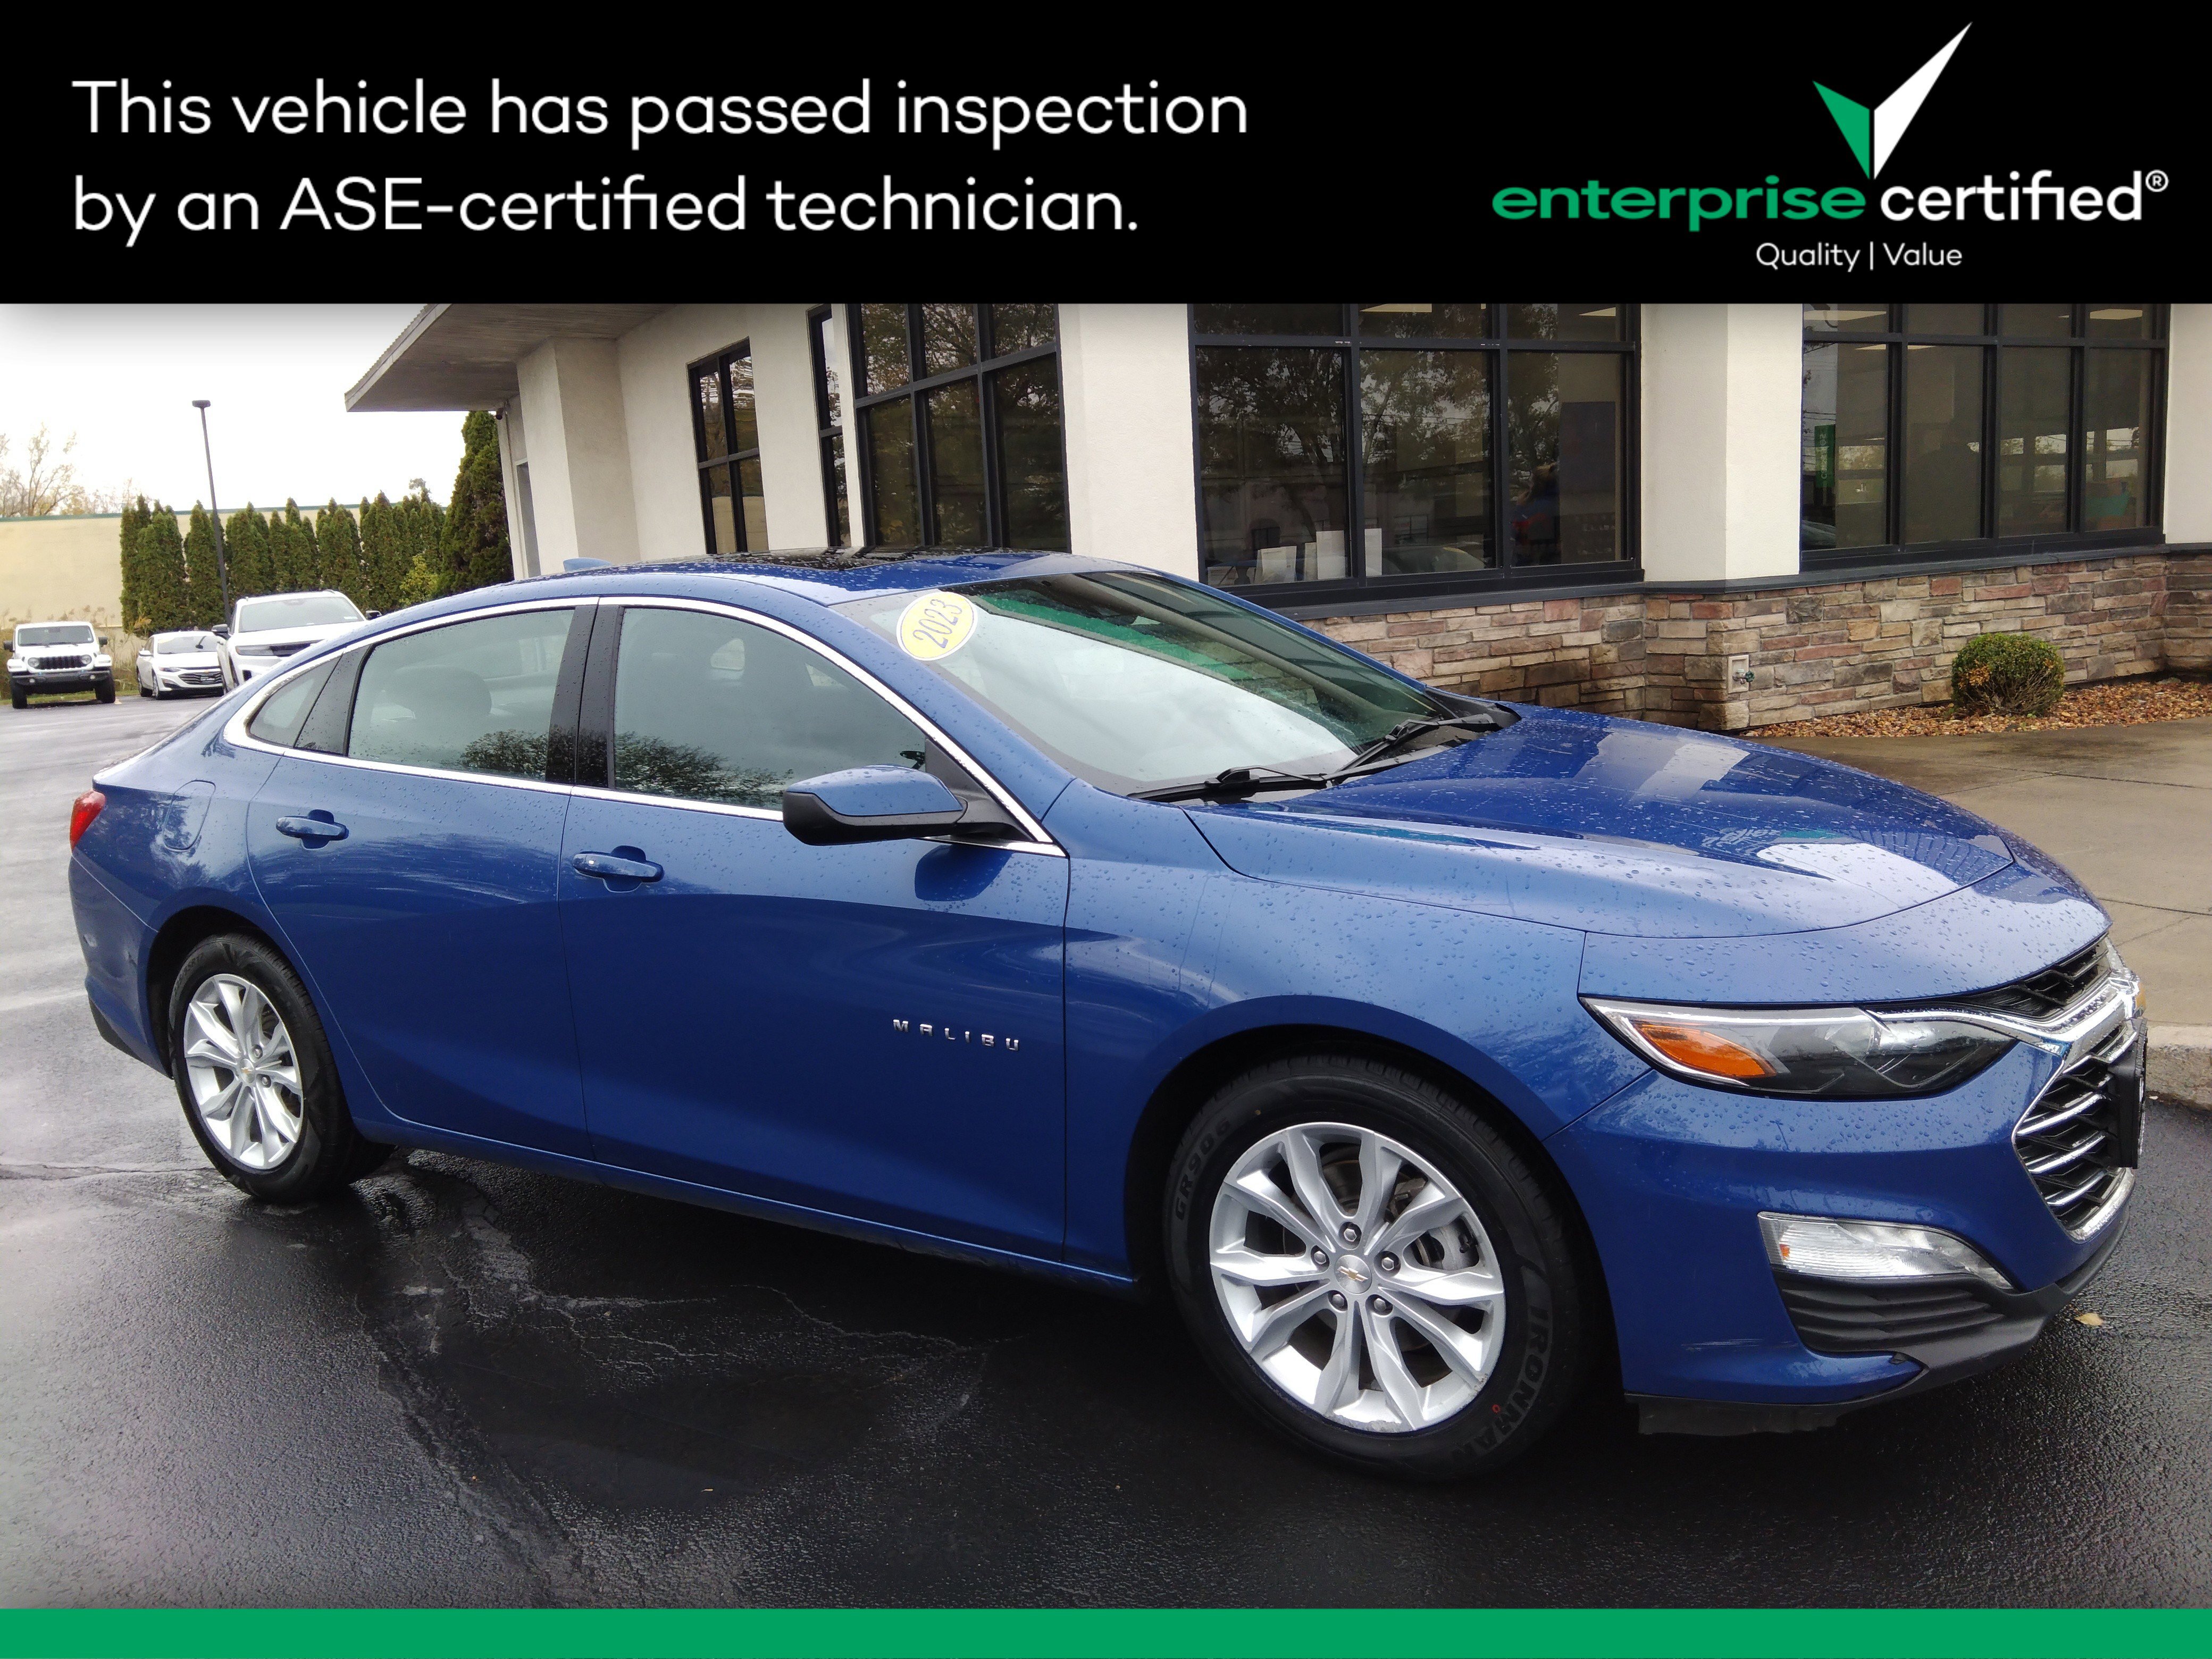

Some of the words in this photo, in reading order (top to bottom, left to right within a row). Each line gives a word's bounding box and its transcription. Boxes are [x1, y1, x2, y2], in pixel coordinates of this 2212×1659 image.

[912, 599, 962, 648] 2023
[893, 1019, 1019, 1051] MALIBU
[1175, 1118, 1230, 1221] GR906
